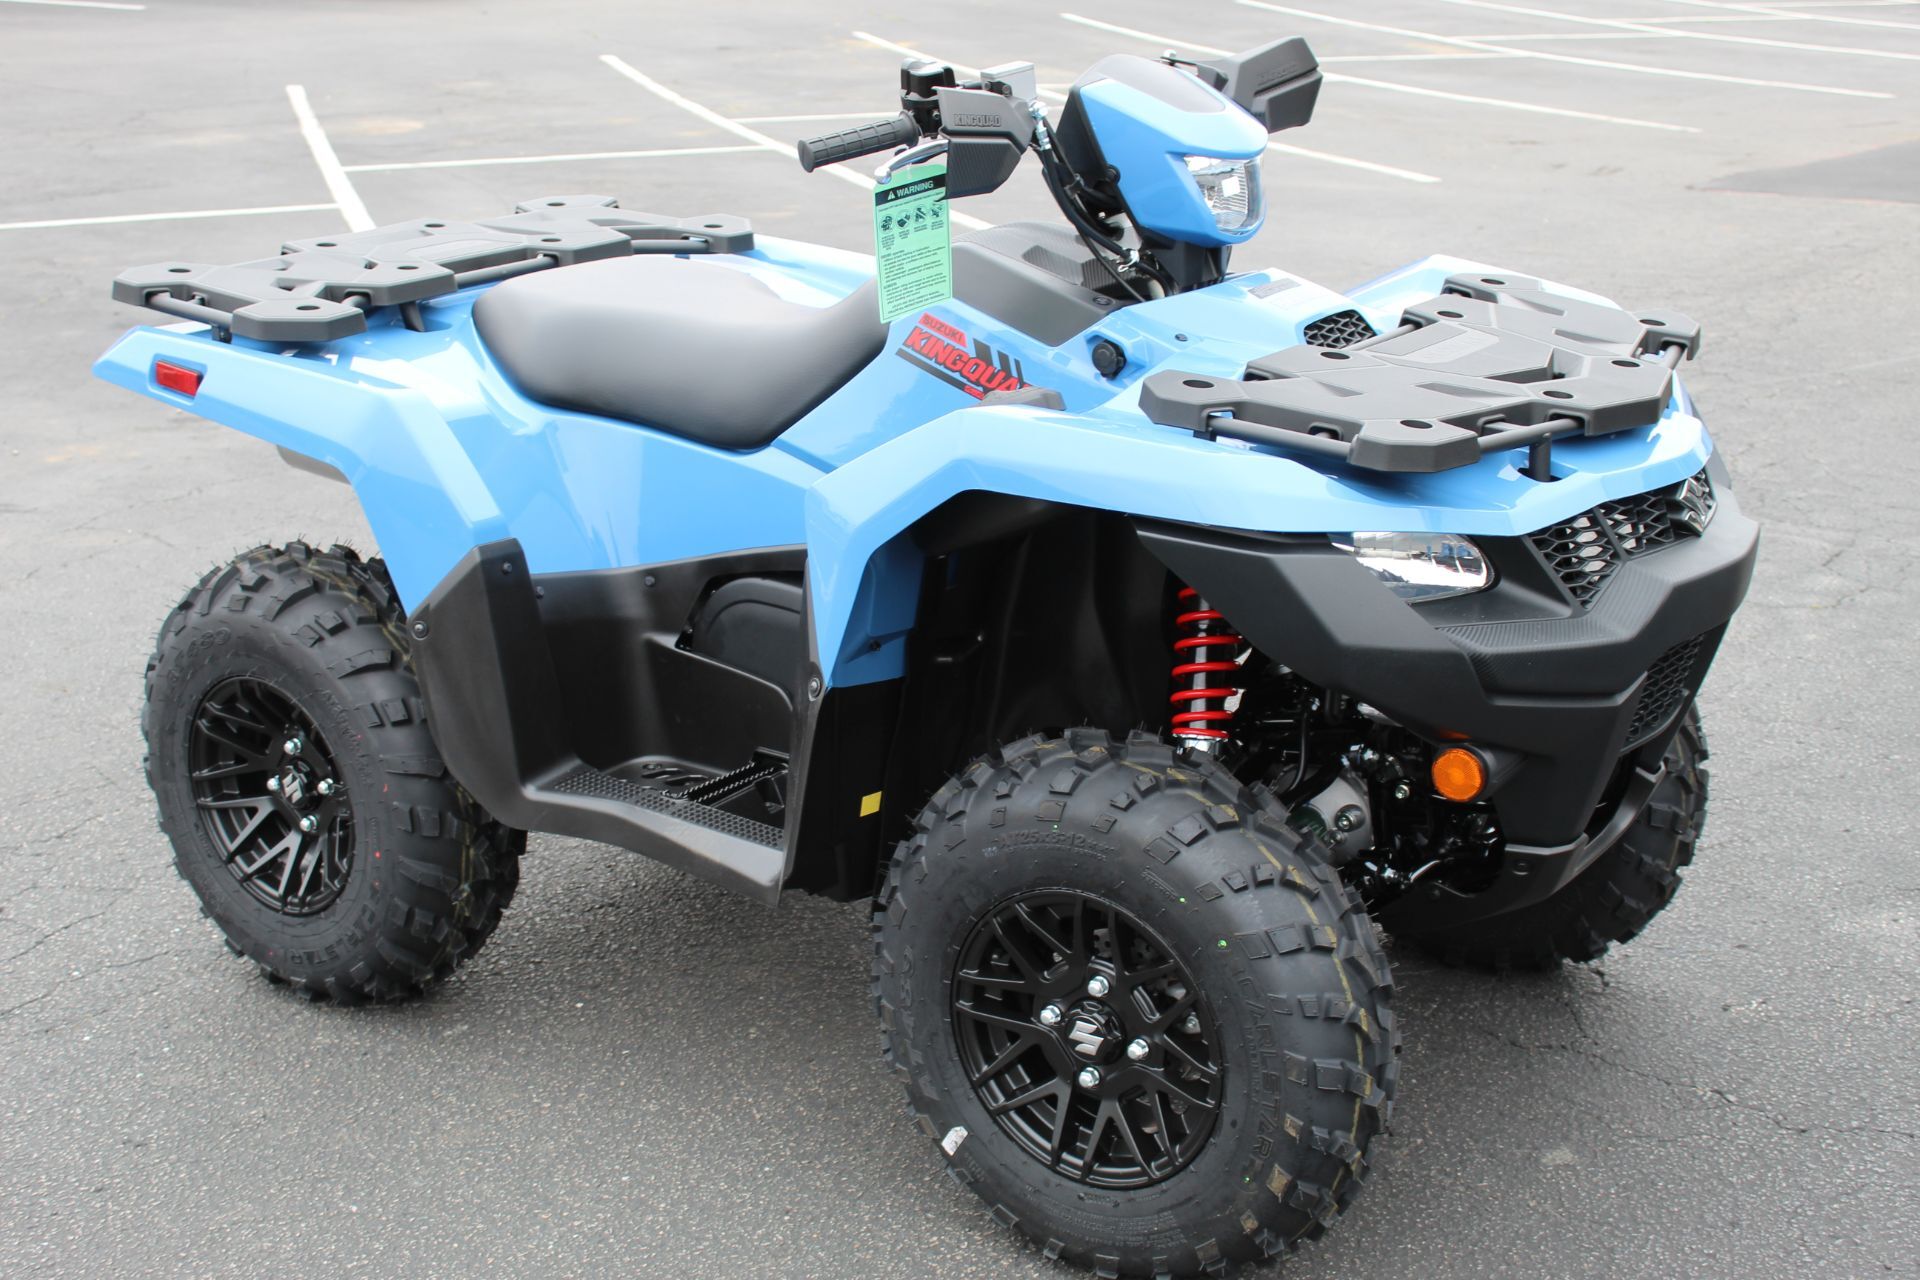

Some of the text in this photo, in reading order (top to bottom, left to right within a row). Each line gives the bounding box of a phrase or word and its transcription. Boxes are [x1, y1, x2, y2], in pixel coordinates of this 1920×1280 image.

[897, 181, 934, 197] WARNING
[923, 316, 966, 343] SUZUKI
[902, 325, 1033, 392] KINGQUA
